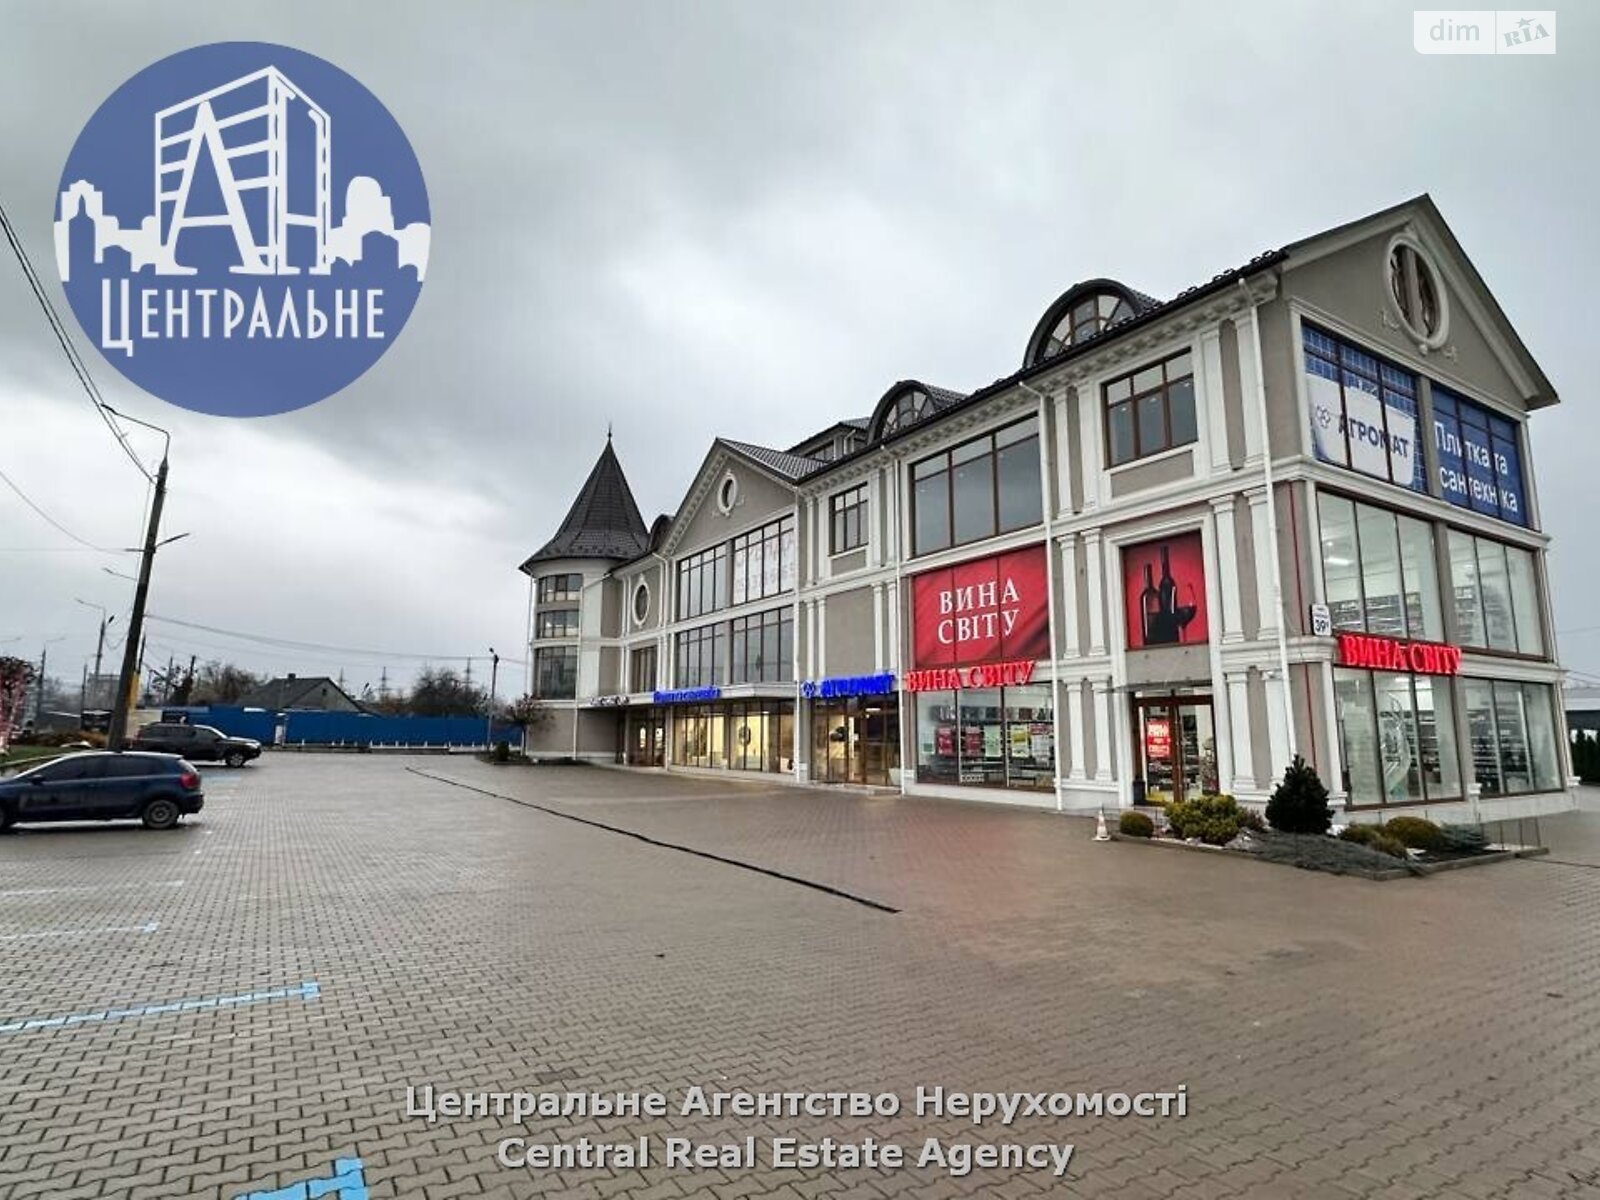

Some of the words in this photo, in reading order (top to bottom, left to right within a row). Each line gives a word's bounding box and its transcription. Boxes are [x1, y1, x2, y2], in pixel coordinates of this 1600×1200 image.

[1439, 467, 1518, 512] сантехнка
[939, 577, 1020, 615] ВИНА
[938, 609, 1020, 644] СВІТУ
[1341, 634, 1409, 670] ВИНА
[1411, 643, 1462, 675] СВІТУ
[905, 667, 962, 692] ВИНА
[968, 660, 1034, 688] СВІТУ
